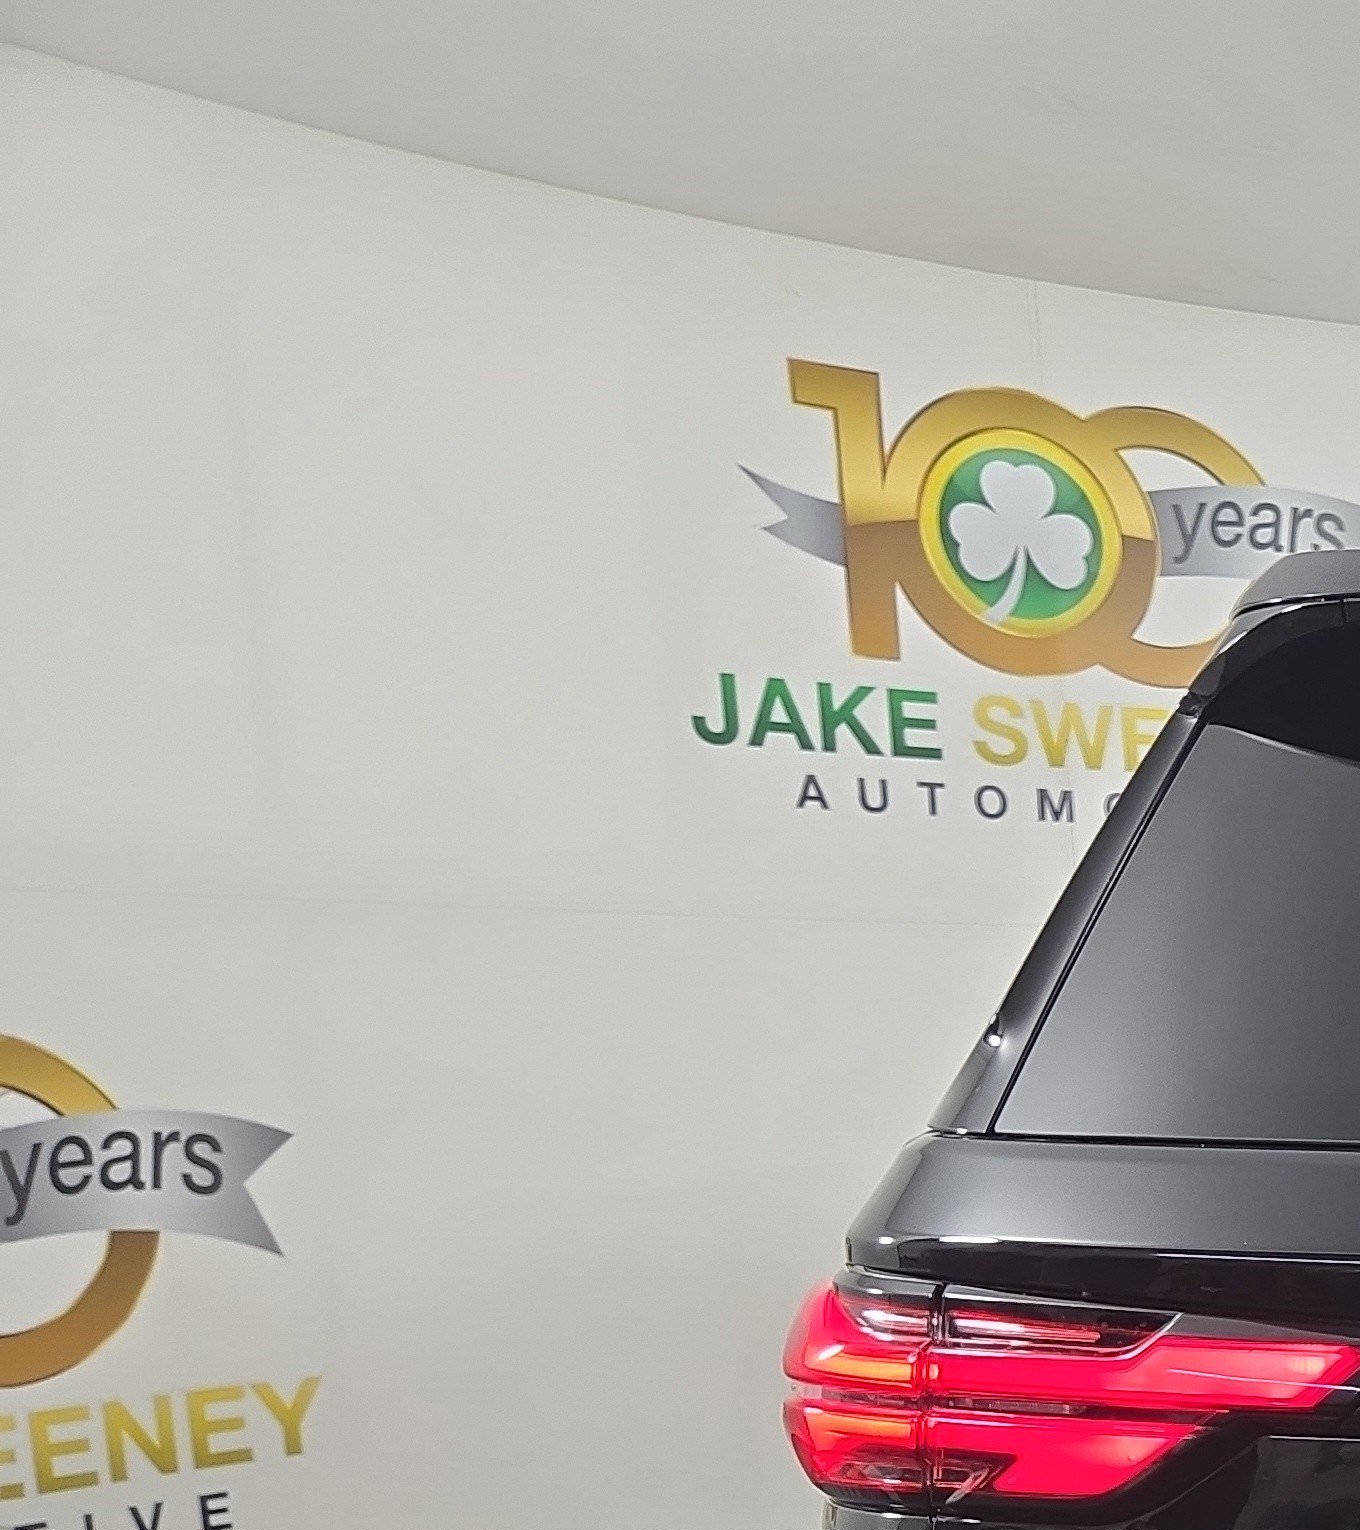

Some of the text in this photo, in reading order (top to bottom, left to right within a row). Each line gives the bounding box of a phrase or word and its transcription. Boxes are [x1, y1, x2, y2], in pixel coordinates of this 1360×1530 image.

[1171, 499, 1346, 565] years
[691, 671, 943, 761] JAKE
[0, 1130, 224, 1226] years
